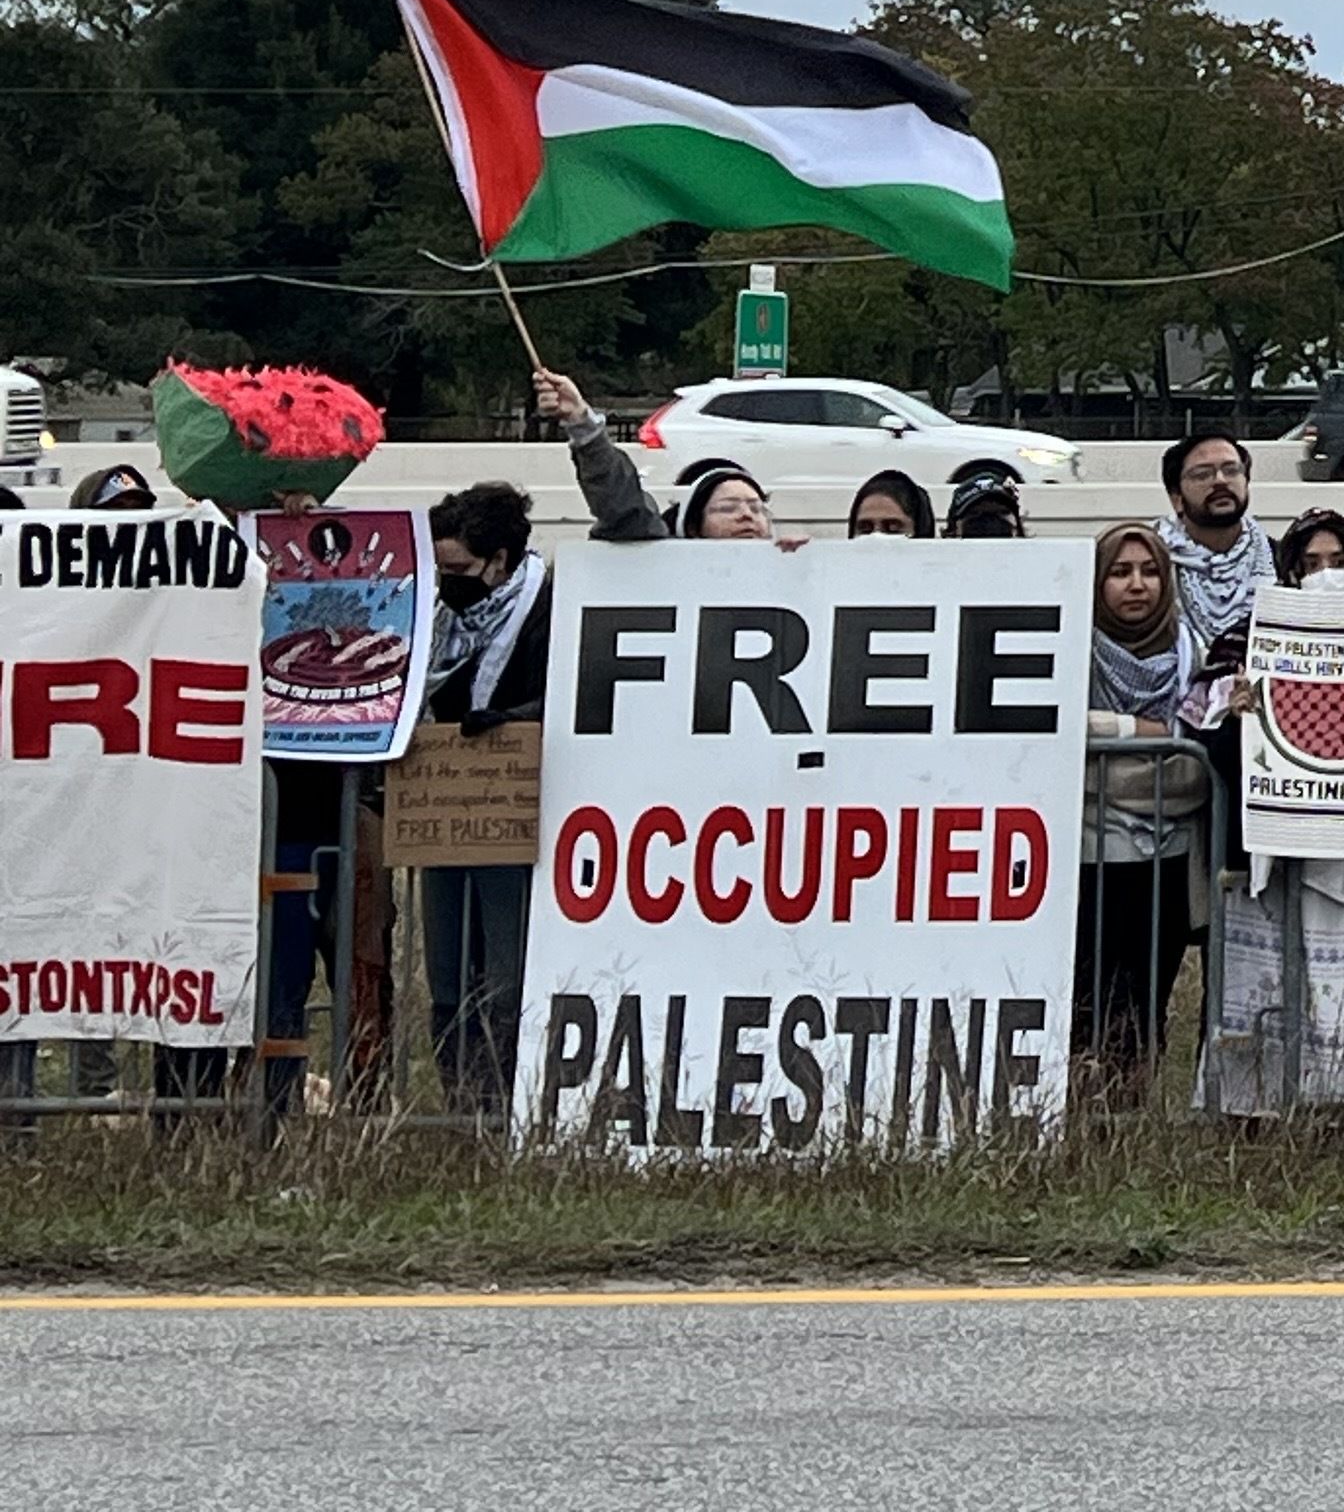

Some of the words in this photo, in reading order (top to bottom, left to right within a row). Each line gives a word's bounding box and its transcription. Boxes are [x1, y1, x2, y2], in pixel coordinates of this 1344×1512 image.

[19, 519, 249, 589] DEMAND
[0, 657, 250, 765] RE
[573, 606, 1061, 735] FREE
[553, 805, 1050, 924] OCCUPIED
[537, 993, 1048, 1151] PALESTINE
